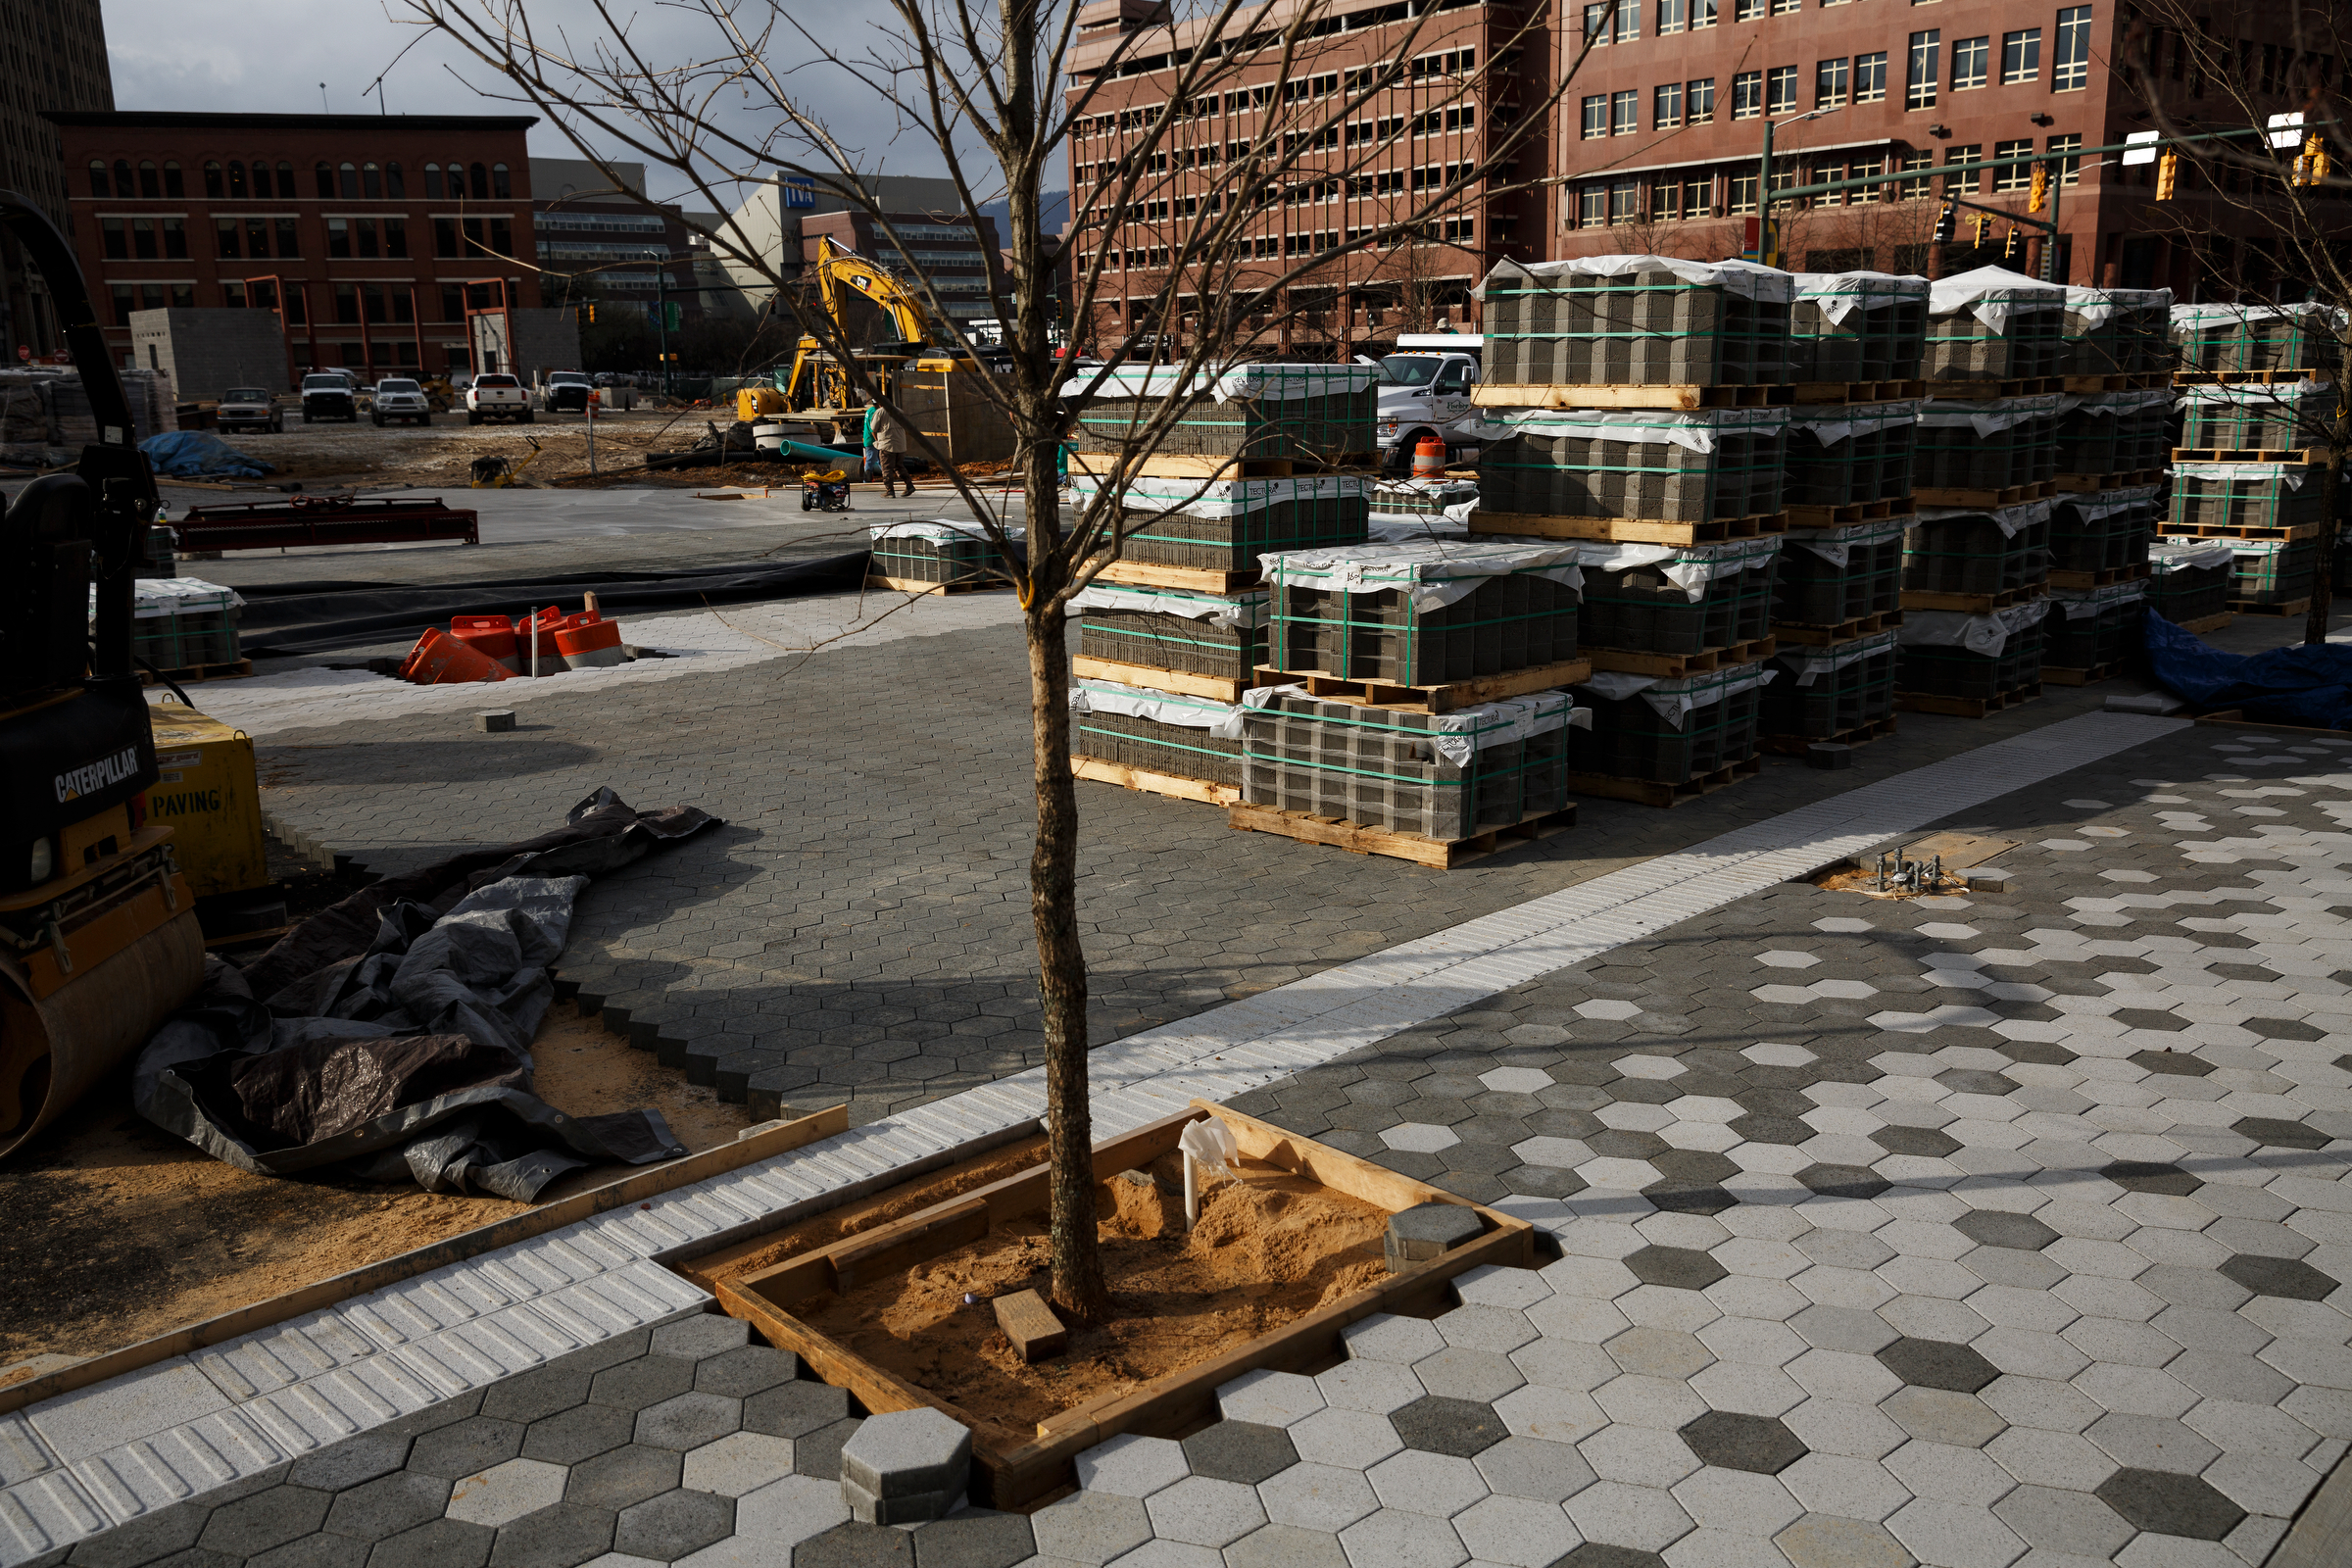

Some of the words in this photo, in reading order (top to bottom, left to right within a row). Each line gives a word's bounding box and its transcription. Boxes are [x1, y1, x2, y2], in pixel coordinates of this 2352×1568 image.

[1478, 711, 1500, 727] TECTURA
[54, 746, 140, 804] CATERPILLAR
[153, 789, 220, 817] PAVING
